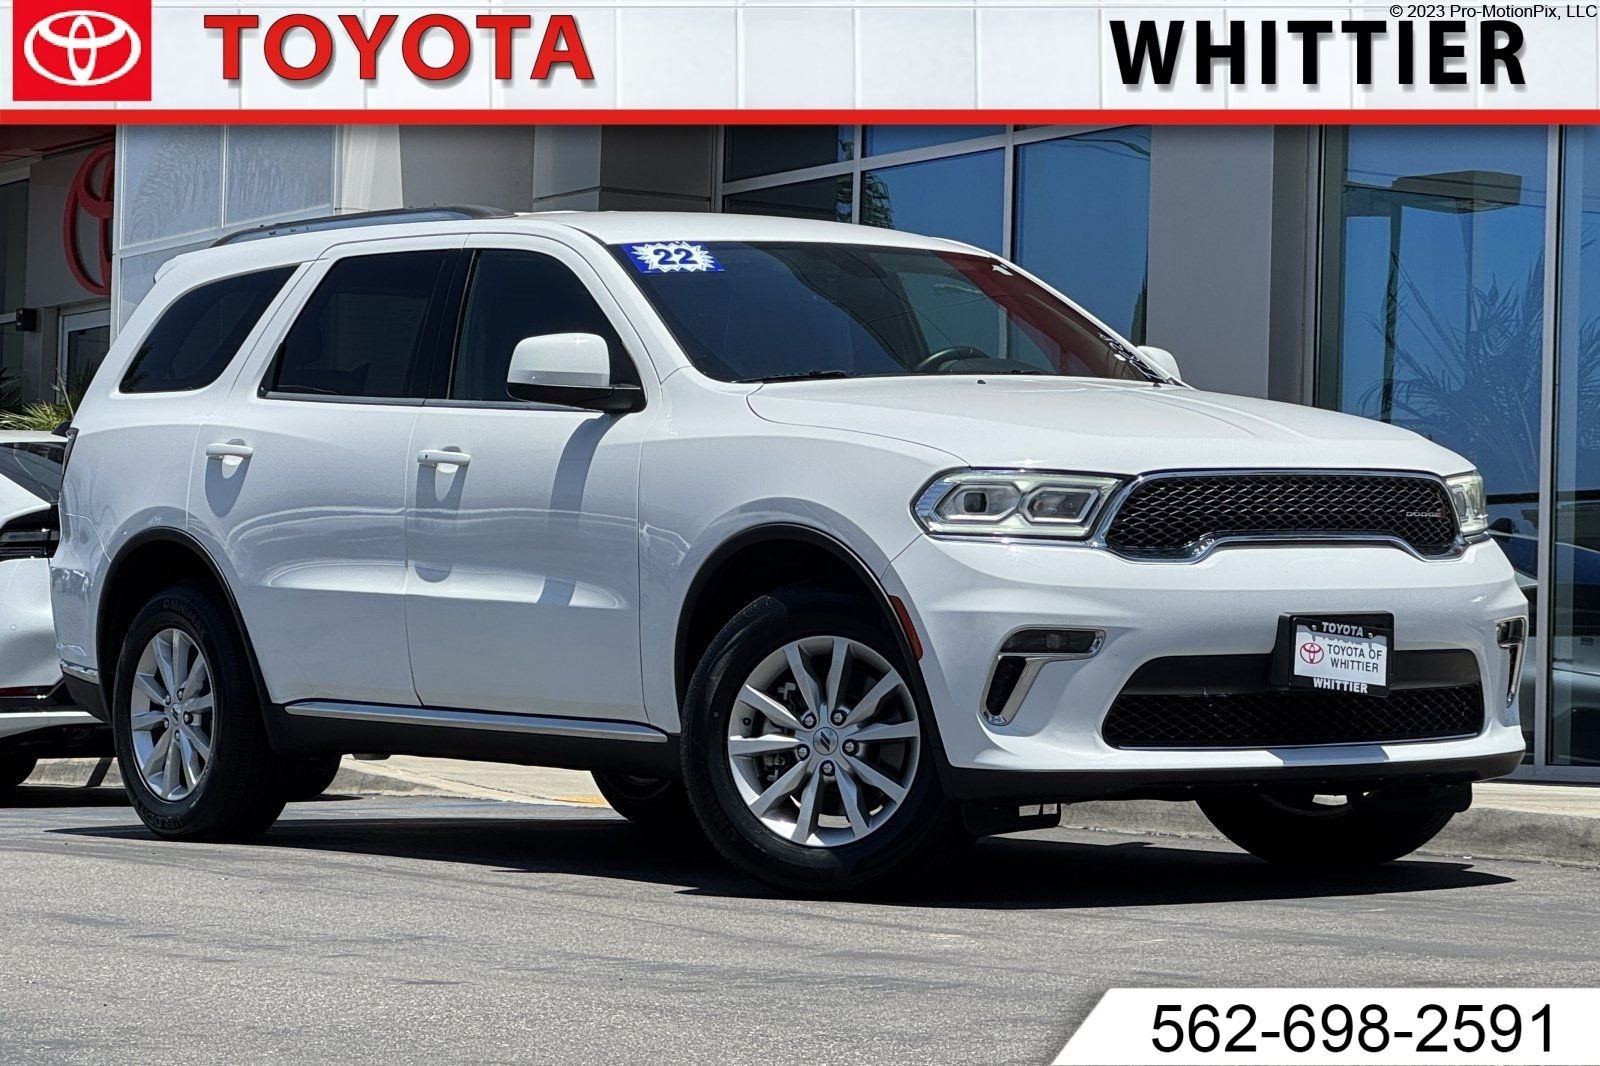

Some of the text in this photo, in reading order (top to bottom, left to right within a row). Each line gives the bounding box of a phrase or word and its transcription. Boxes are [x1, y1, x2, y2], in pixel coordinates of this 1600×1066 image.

[653, 248, 699, 265] 22
[1321, 621, 1364, 637] TOYOTA
[1327, 643, 1383, 660] TOYOTA OF
[1330, 657, 1379, 673] WHITTIER
[1313, 677, 1368, 694] WHITTIER
